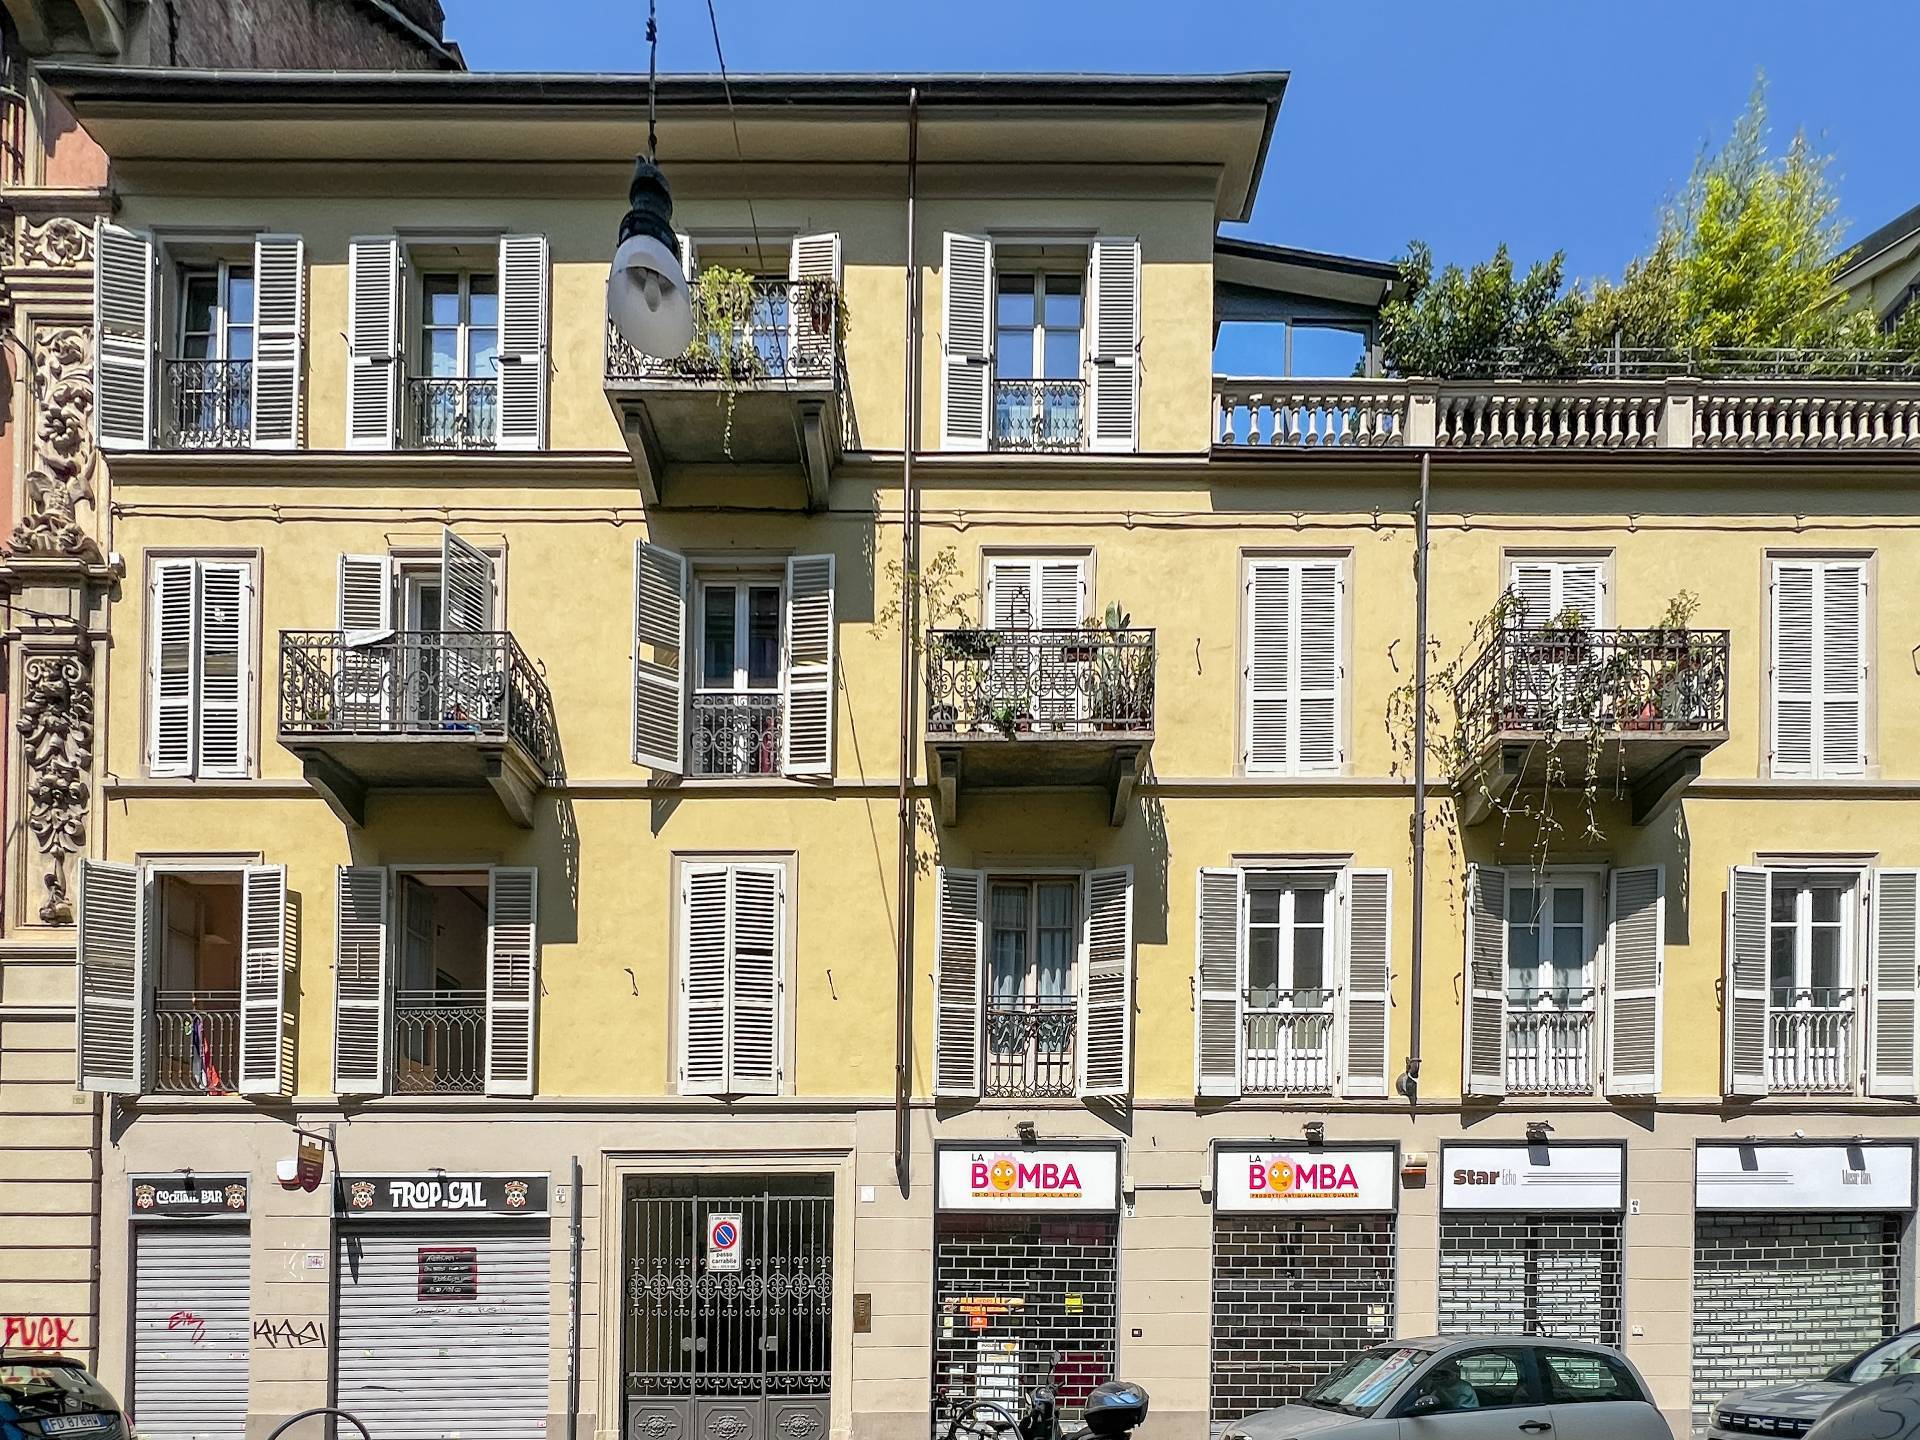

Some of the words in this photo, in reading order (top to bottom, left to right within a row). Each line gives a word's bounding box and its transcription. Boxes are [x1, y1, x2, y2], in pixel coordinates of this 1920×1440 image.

[972, 1153, 984, 1161] LA
[1249, 1154, 1262, 1162] LA
[1453, 1169, 1500, 1185] Star
[201, 1190, 223, 1204] BAR
[389, 1181, 487, 1208] TROPICAL
[4, 1317, 79, 1347] FUCK
